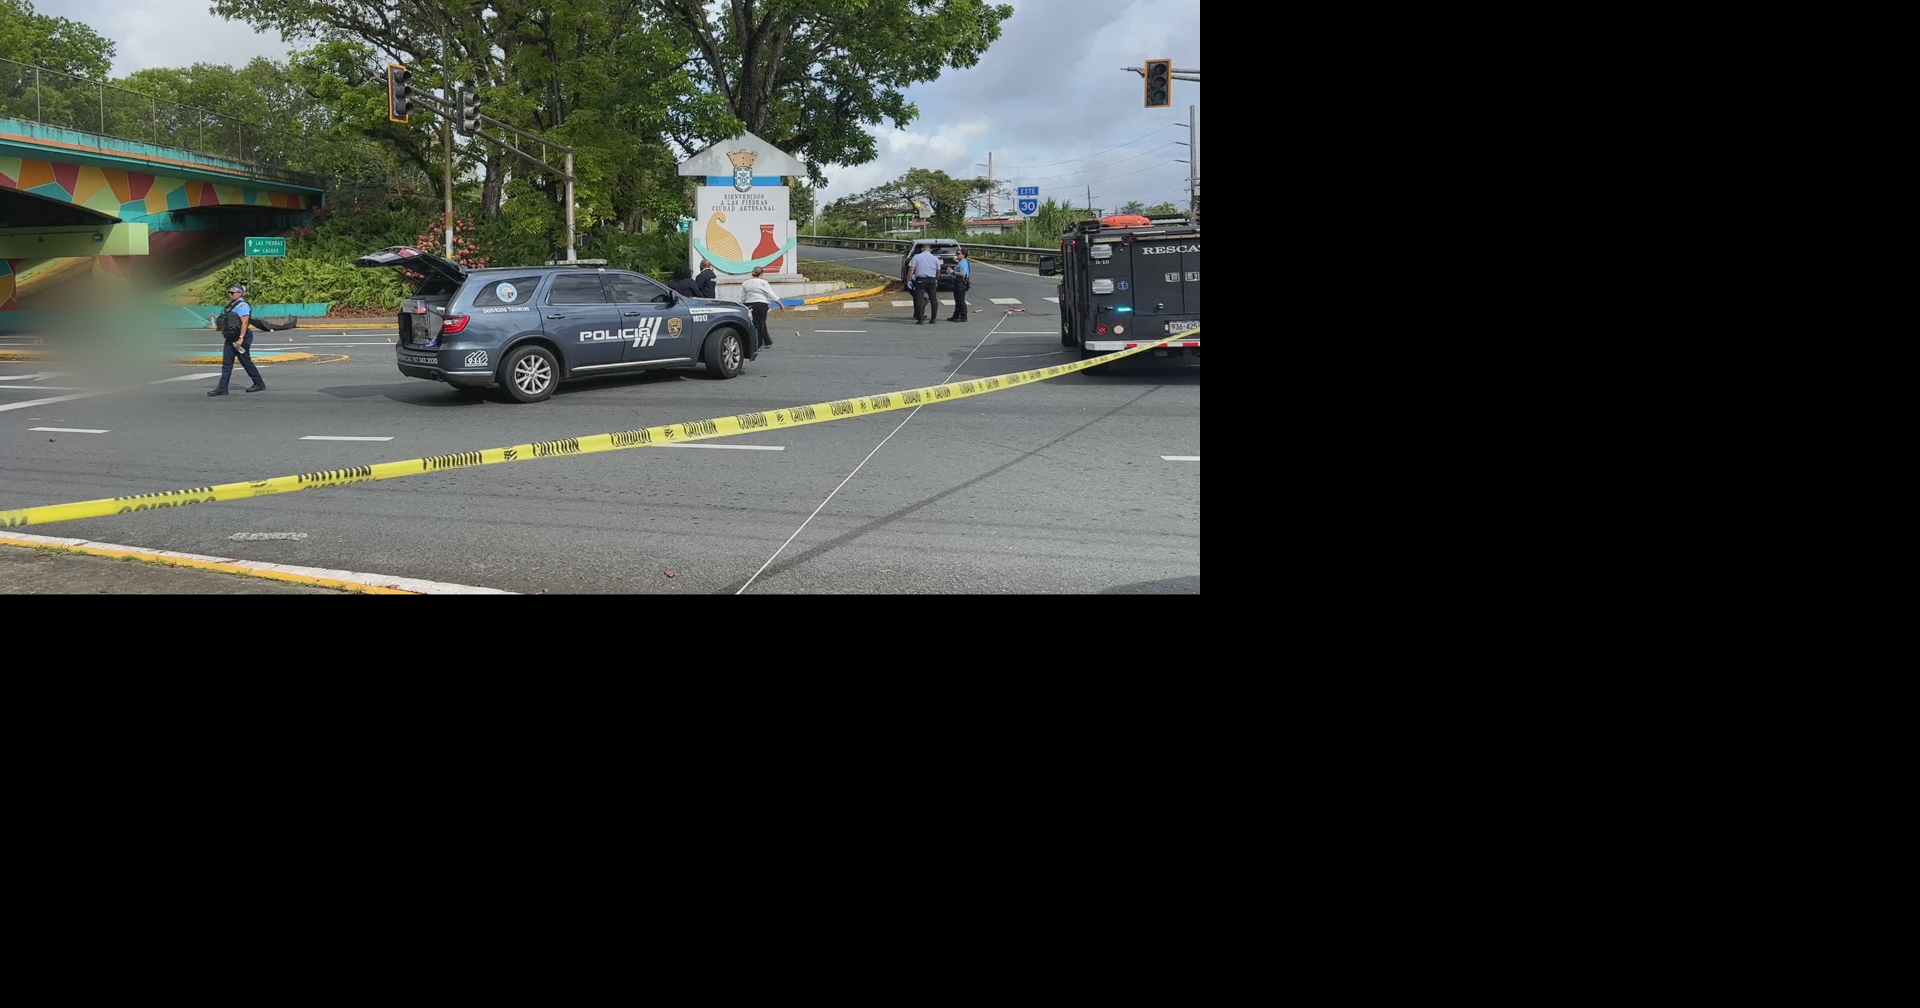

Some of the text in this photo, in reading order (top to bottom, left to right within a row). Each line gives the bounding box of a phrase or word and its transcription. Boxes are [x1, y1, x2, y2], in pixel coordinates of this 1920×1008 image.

[1021, 201, 1035, 211] 30
[692, 314, 708, 323] 10317
[1171, 322, 1198, 331] 936-425
[579, 327, 651, 342] POLICIA
[531, 437, 580, 457] CAUTION
[609, 428, 652, 447] CUIDADO
[681, 419, 719, 437] CAUTION
[736, 412, 768, 429] CUIDADO
[788, 406, 816, 422] CAUTION
[828, 401, 854, 416] CUIDADO
[869, 395, 892, 410] CAUTION
